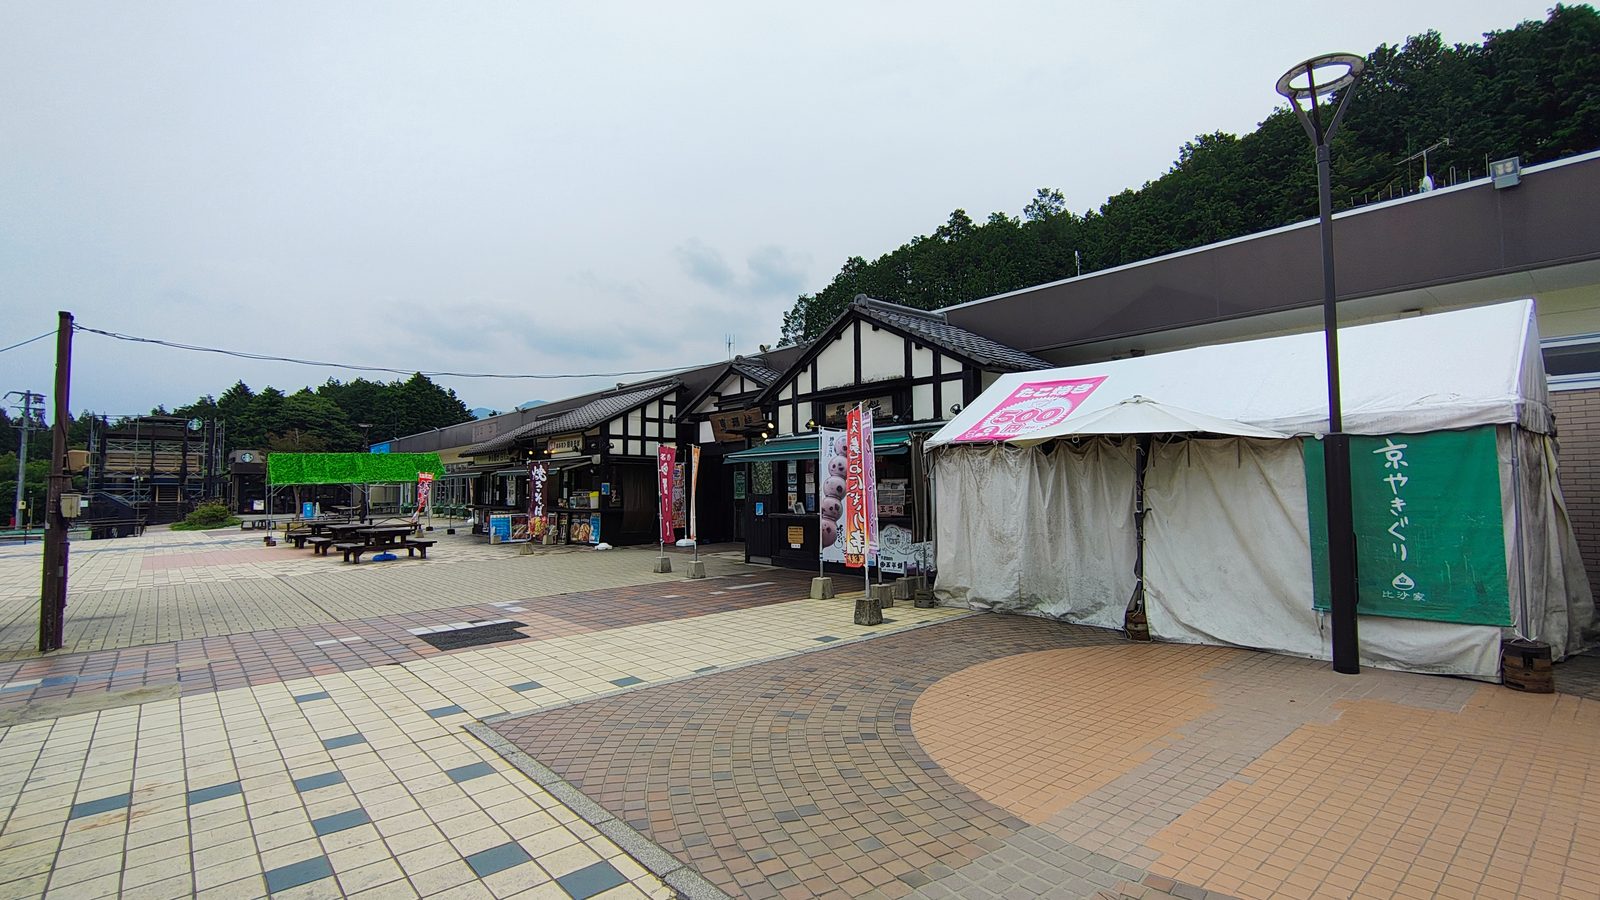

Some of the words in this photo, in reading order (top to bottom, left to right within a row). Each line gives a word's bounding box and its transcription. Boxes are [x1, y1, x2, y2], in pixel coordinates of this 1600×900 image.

[1015, 383, 1094, 398] たこ焼き
[992, 407, 1065, 425] 500
[531, 464, 547, 517] 焼きそば
[1373, 438, 1409, 562] 京やきぐり
[1382, 590, 1426, 602] 比沙家
